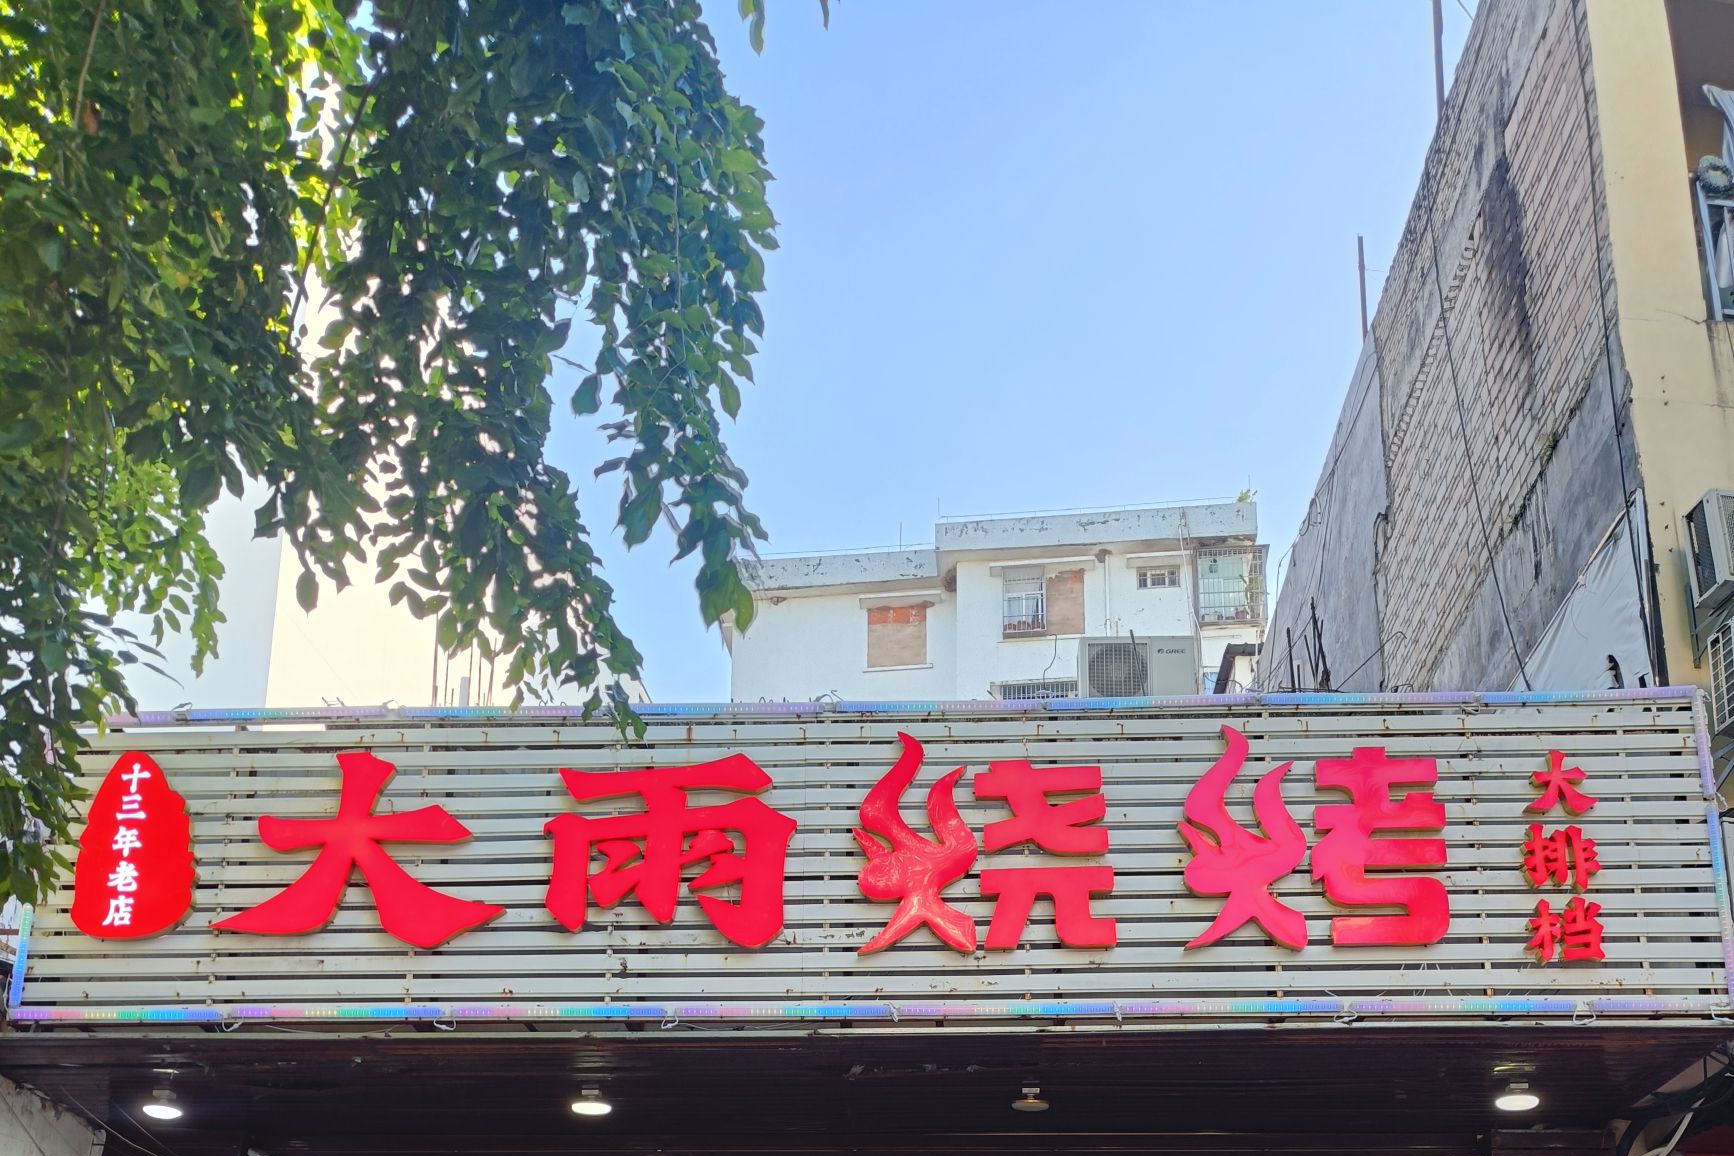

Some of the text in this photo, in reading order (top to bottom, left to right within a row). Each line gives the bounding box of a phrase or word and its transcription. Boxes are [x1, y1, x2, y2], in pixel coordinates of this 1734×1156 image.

[102, 762, 152, 927] 十三年老店
[211, 724, 1451, 957] 大雨烧烤
[1520, 749, 1606, 966] 大排档
